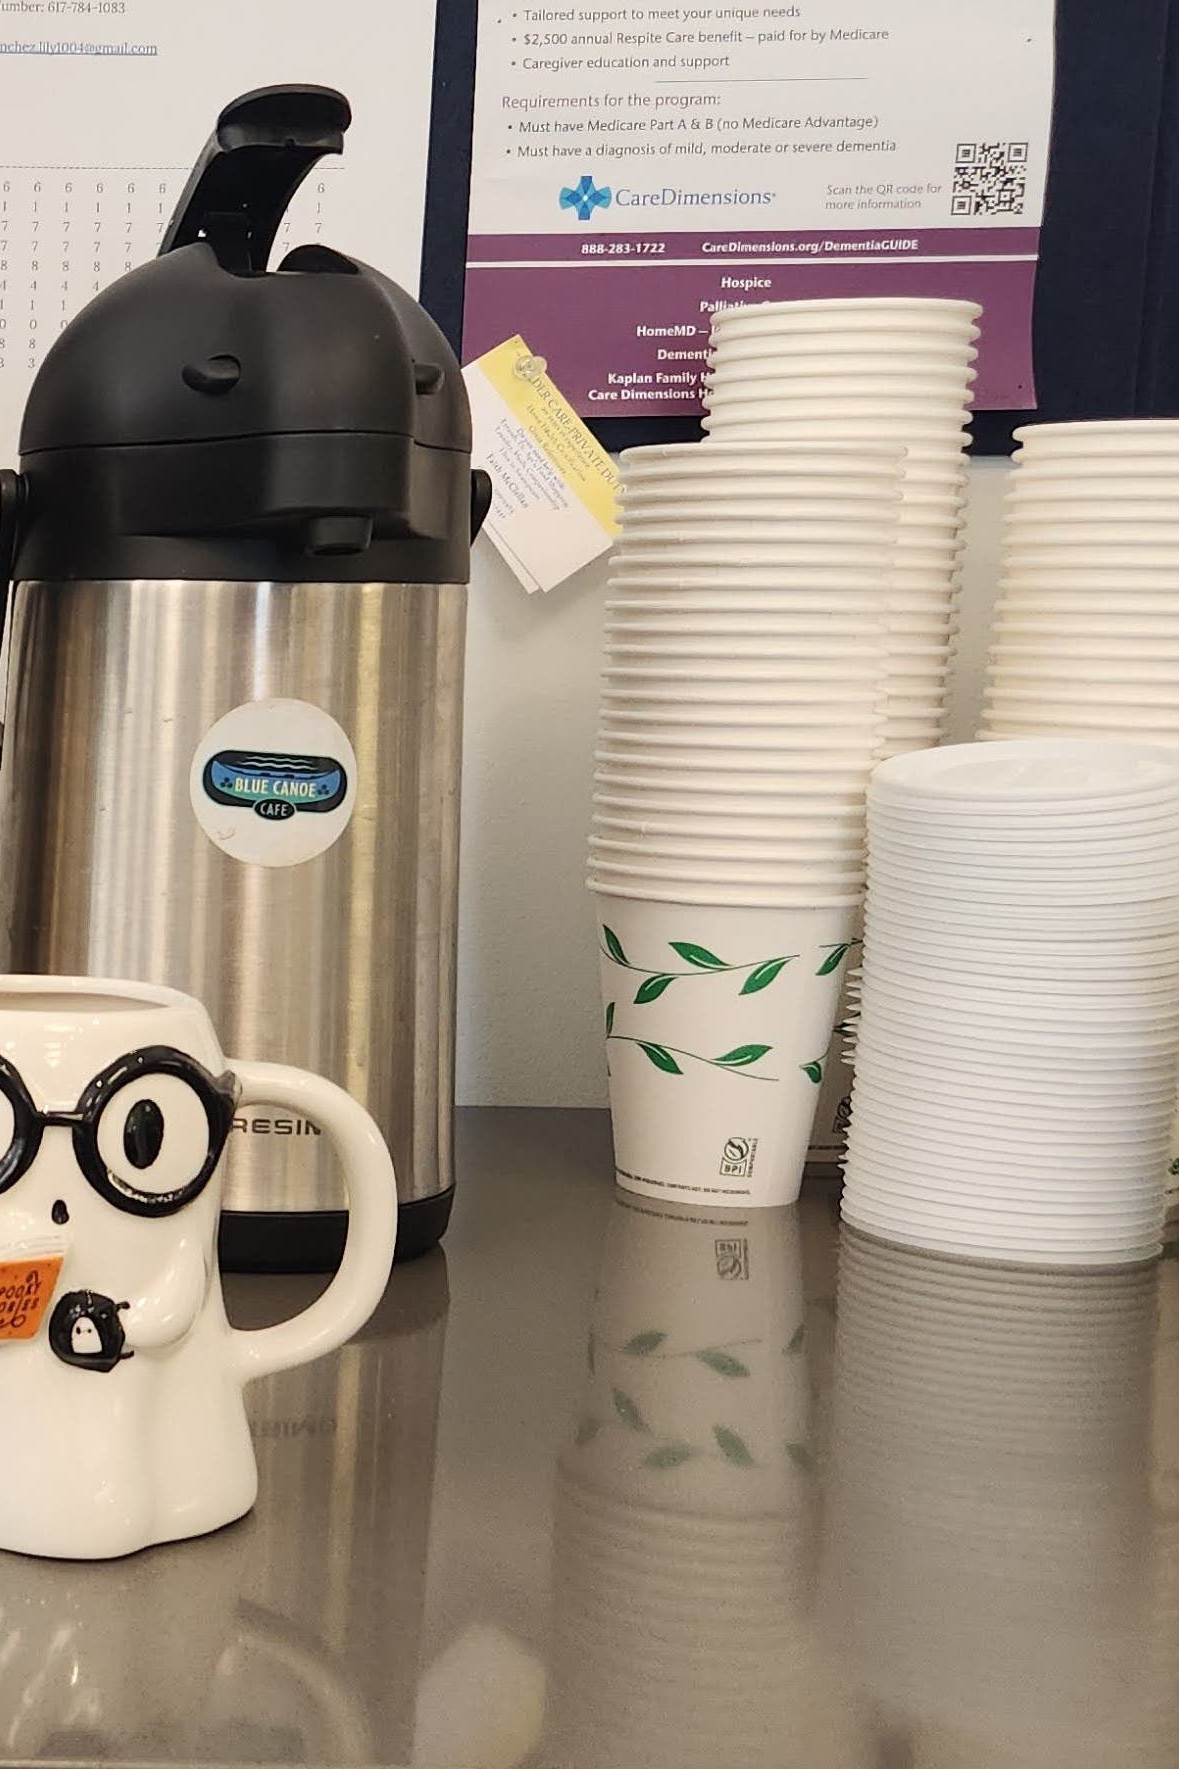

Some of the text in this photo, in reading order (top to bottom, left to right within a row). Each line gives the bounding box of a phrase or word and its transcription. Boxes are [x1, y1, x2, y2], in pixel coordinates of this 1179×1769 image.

[47, 2, 126, 14] 617-784-1083
[524, 6, 800, 23] Tailored support to meet your unique needs
[524, 29, 890, 47] $2,500 annual Respite Care benefit paid for by Medicare
[523, 56, 730, 72] Caregiver education and support
[502, 94, 722, 111] Requirements for the program:
[519, 116, 878, 132] Must have Medicare Part A & B (no Medicare Advantage)
[518, 140, 896, 158] Must have a diagnosis of mild, moderate or severe dementia
[826, 183, 942, 196] Scan the QR code for
[616, 188, 772, 206] CareDimensions
[825, 199, 921, 210] more information
[581, 240, 918, 254] 888-283-1722 CareDimensions.org/DementiaGUIDE
[721, 277, 772, 291] Hospice
[636, 326, 696, 336] HomeMD
[608, 373, 652, 386] Kaplan
[656, 372, 697, 386] Family
[588, 390, 618, 400] Care
[621, 388, 696, 400] Dimensions
[235, 778, 316, 798] BLUE CANOE
[260, 803, 288, 816] CAFE
